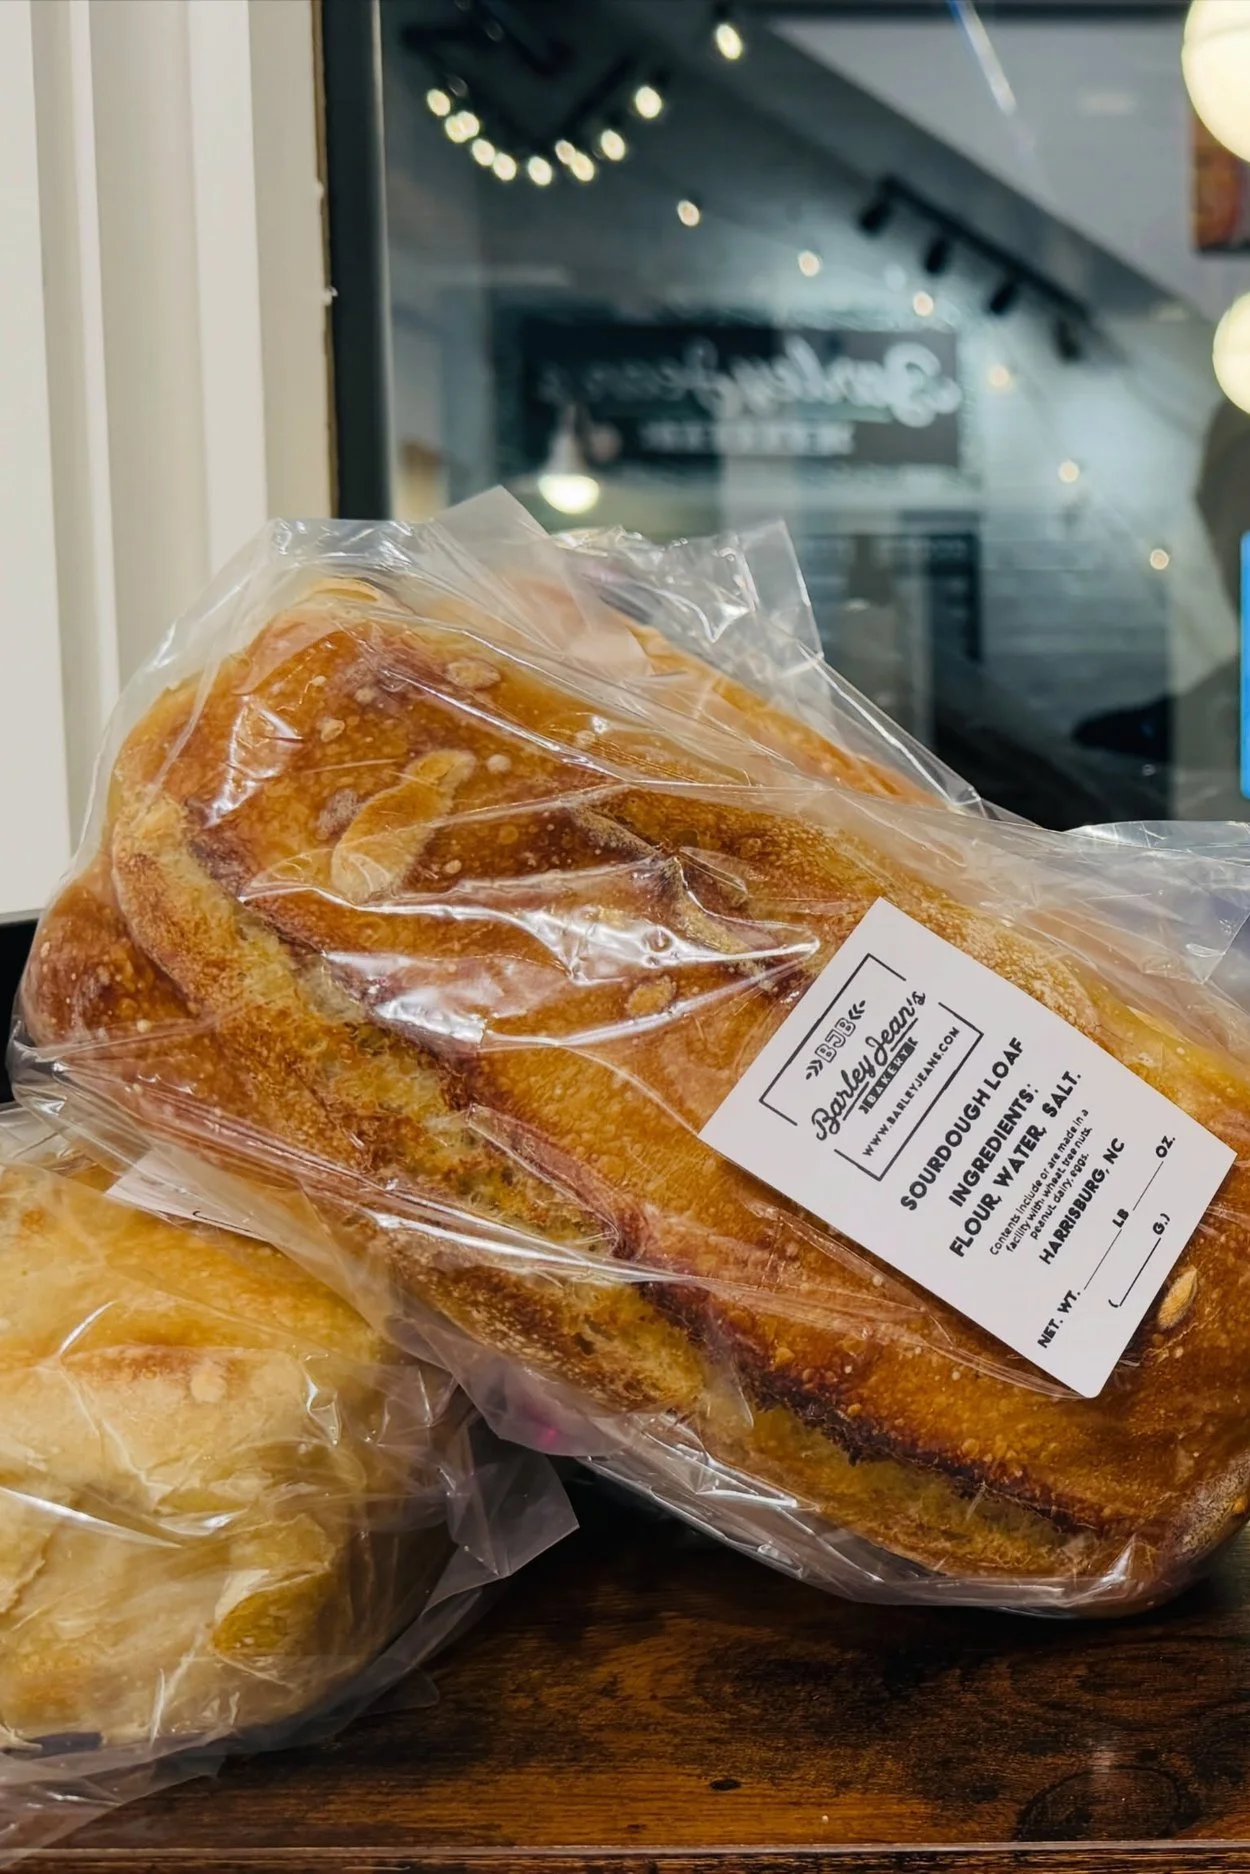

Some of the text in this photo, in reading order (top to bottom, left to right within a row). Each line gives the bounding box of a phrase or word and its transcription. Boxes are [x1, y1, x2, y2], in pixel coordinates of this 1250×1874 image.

[811, 990, 926, 1141] Barley Jean's
[814, 1017, 856, 1063] BJB
[862, 1027, 960, 1156] WWW.BARLEYJEANS.COM
[864, 1045, 913, 1106] BAKERY
[901, 1037, 1023, 1211] SOURDOUGH LOAF
[949, 1084, 1038, 1207] INGREDIENTS:
[949, 1071, 1081, 1257] FLOUR, WATER, SALT.
[990, 1109, 1088, 1255] Contents include or are made in a
[1070, 1154, 1089, 1177] eggs.
[1006, 1221, 1031, 1252] facility
[1062, 1148, 1077, 1166] tree
[1037, 1136, 1175, 1348] NET. WT. LB OZ.
[1039, 1138, 1124, 1265] HARRISBURG, NC
